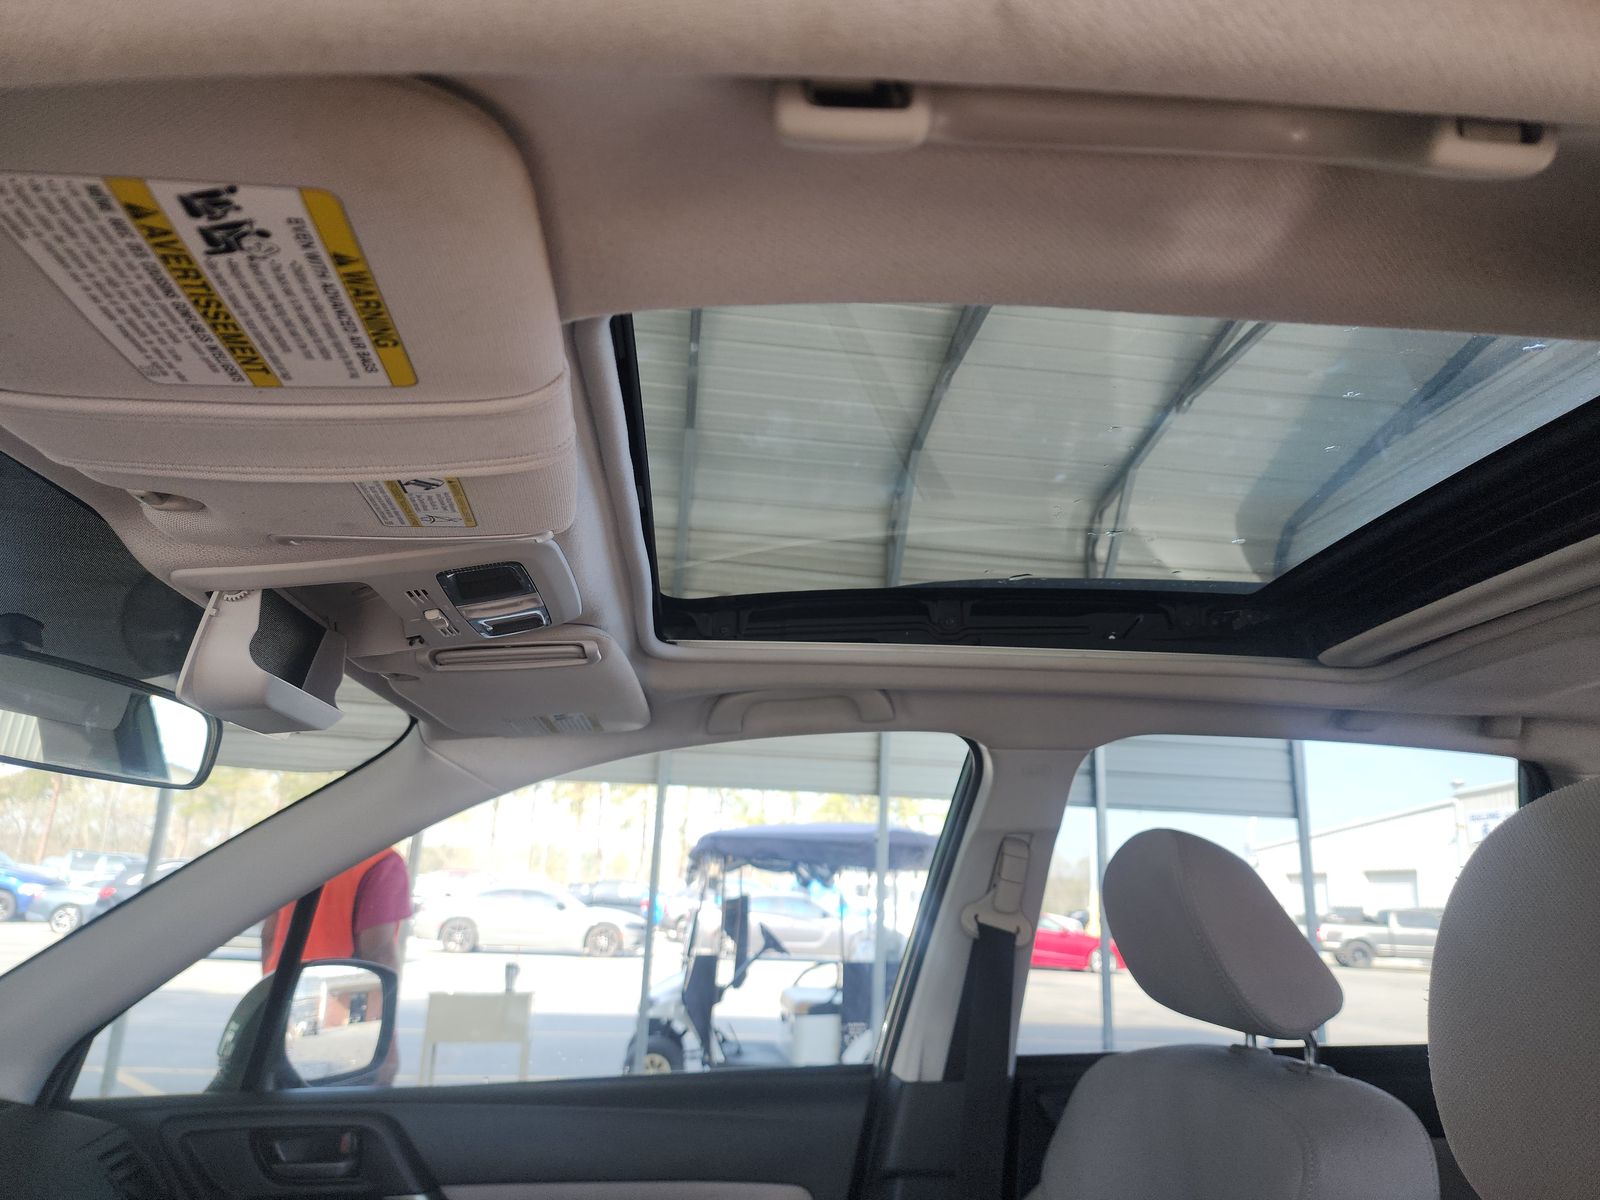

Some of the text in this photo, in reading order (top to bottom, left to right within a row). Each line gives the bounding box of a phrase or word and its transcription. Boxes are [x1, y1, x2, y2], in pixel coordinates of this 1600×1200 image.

[138, 224, 270, 374] AVERTISSEMENT
[286, 217, 379, 374] EVEN WITH ADVANCED AIR BAGS
[343, 270, 400, 348] WARNING
